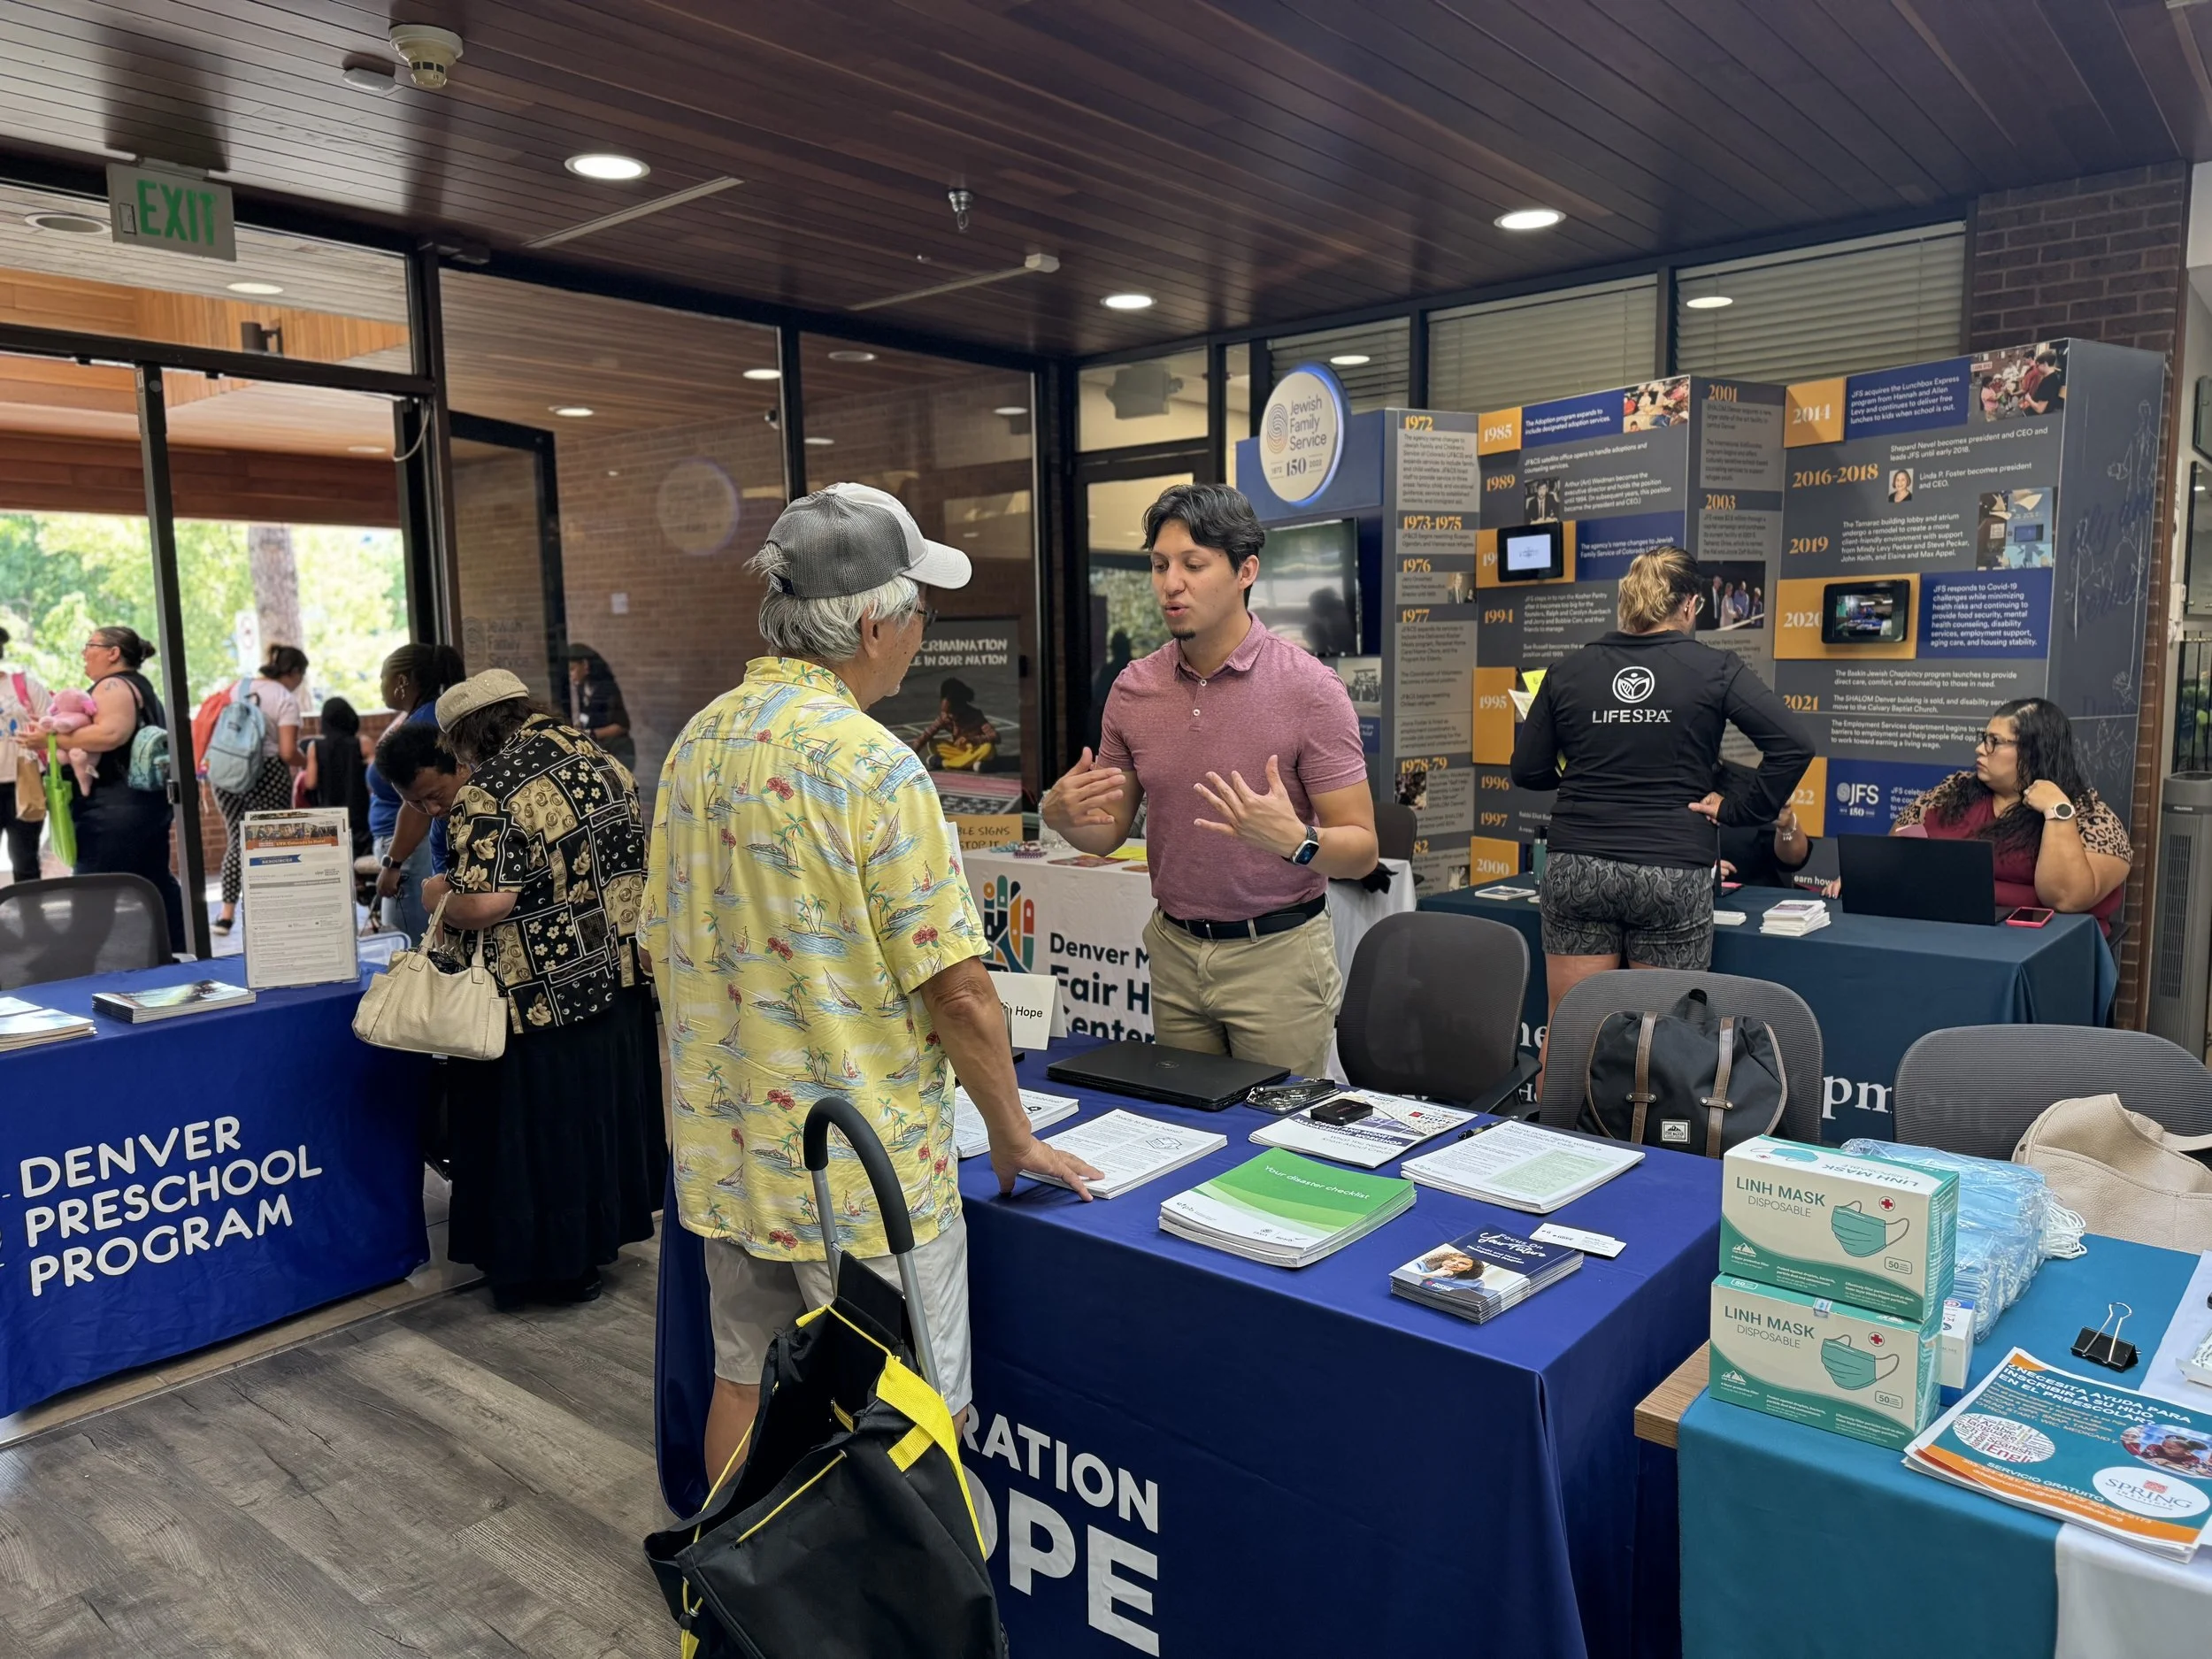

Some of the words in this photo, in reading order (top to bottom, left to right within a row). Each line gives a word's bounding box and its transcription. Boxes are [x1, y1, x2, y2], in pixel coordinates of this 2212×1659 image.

[137, 180, 217, 246] EXIT
[1708, 384, 1738, 403] 2001
[1864, 388, 1889, 397] acquires
[1902, 380, 1933, 390] Lunchbox
[1935, 376, 1959, 387] Express
[1290, 395, 1323, 418] Jewish
[1851, 398, 1877, 408] program
[1893, 390, 1916, 400] Hannah
[1851, 408, 1864, 417] Levy
[1878, 402, 1908, 411] continues
[1917, 397, 1938, 406] deliver
[1535, 417, 1555, 426] Adoption
[1577, 411, 1596, 419] expands
[1793, 403, 1831, 424] 2014
[1851, 415, 1873, 425] lunches
[1882, 411, 1893, 420] kids
[1895, 410, 1912, 419] when
[1914, 406, 1934, 416] school
[1289, 413, 1321, 435] Family
[1404, 415, 1434, 433] 1972
[1483, 424, 1513, 442] 1985
[1289, 433, 1327, 451] Service
[1891, 443, 1916, 453] Shepard
[1938, 438, 1966, 447] becomes
[1969, 434, 2001, 444] president
[2016, 428, 2032, 437] CEO
[1921, 449, 1935, 458] until
[1936, 449, 1951, 457] early
[1286, 457, 1307, 477] 150
[1792, 463, 1878, 488] 2016-2018
[1920, 472, 1937, 481] Linda
[1946, 469, 1966, 478] Foster
[1968, 465, 1998, 475] becomes
[2000, 463, 2032, 473] president
[1486, 473, 1517, 492] 1989
[1705, 494, 1736, 511] 2003
[1403, 515, 1463, 531] 1973-1975
[1789, 536, 1829, 554] 2019
[1402, 558, 1432, 573] 1976
[1947, 584, 1978, 593] responds
[1987, 582, 2017, 591] Covid-19
[1402, 608, 1430, 624] 1977
[920, 639, 1008, 652] CRIMINATION
[924, 655, 936, 666] IN
[938, 655, 963, 666] OUR
[965, 654, 1008, 665] NATION
[1889, 670, 1923, 679] Chaplaincy
[1479, 695, 1507, 710] 1995
[1783, 695, 1819, 711] 2021
[1401, 757, 1448, 773] 1978-79
[1480, 776, 1509, 791] 1996
[1848, 783, 1879, 806] JFS
[1480, 812, 1508, 827] 1997
[978, 826, 1010, 836] SIGNS
[960, 841, 986, 849] STOP
[1477, 859, 1509, 876] 2000
[1050, 932, 1129, 965] Denver
[1049, 964, 1118, 1006] Fair
[1016, 1006, 1043, 1019] Hope
[1063, 1005, 1156, 1044] enter
[1295, 1118, 1354, 1135] MANAGEMENT
[1356, 1133, 1403, 1145] WORKSHOP
[19, 1116, 242, 1199] DENVER
[1823, 1164, 1872, 1177] MASK
[1263, 1165, 1285, 1179] Your
[1286, 1173, 1325, 1189] disaster
[1325, 1184, 1371, 1200] checklist
[1877, 1175, 1918, 1187] LINH
[25, 1144, 323, 1248] PRESCHOOL
[1736, 1177, 1772, 1196] LINH
[1778, 1186, 1825, 1207] MASK
[1748, 1195, 1811, 1217] DISPOSABLE
[30, 1194, 293, 1297] PROGRAM
[1888, 1261, 1899, 1270] 50
[1725, 1306, 1761, 1325] LINH
[1767, 1317, 1815, 1339] MASK
[1737, 1325, 1801, 1349] DISPOSABLE
[1878, 1394, 1890, 1403] 50
[1998, 1373, 2018, 1386] EN
[2021, 1383, 2039, 1394] EL
[2043, 1388, 2156, 1425] PREESCOLAR?
[2002, 1367, 2076, 1397] INSCRIBIR
[2091, 1397, 2115, 1409] SU
[2117, 1404, 2154, 1419] HIJO
[2090, 1393, 2143, 1412] AYUDA
[2147, 1405, 2192, 1424] PARA
[1966, 1418, 2018, 1441] language
[1981, 1419, 2017, 1436] Arabic
[1986, 1436, 2032, 1456] Spanish
[1987, 1444, 2032, 1463] Engli
[964, 1402, 1158, 1533] RATION
[1986, 1462, 2040, 1483] SERVICIO
[2043, 1479, 2105, 1502] GRATUITO
[2105, 1479, 2193, 1509] SPRING
[962, 1463, 1159, 1657] PE
